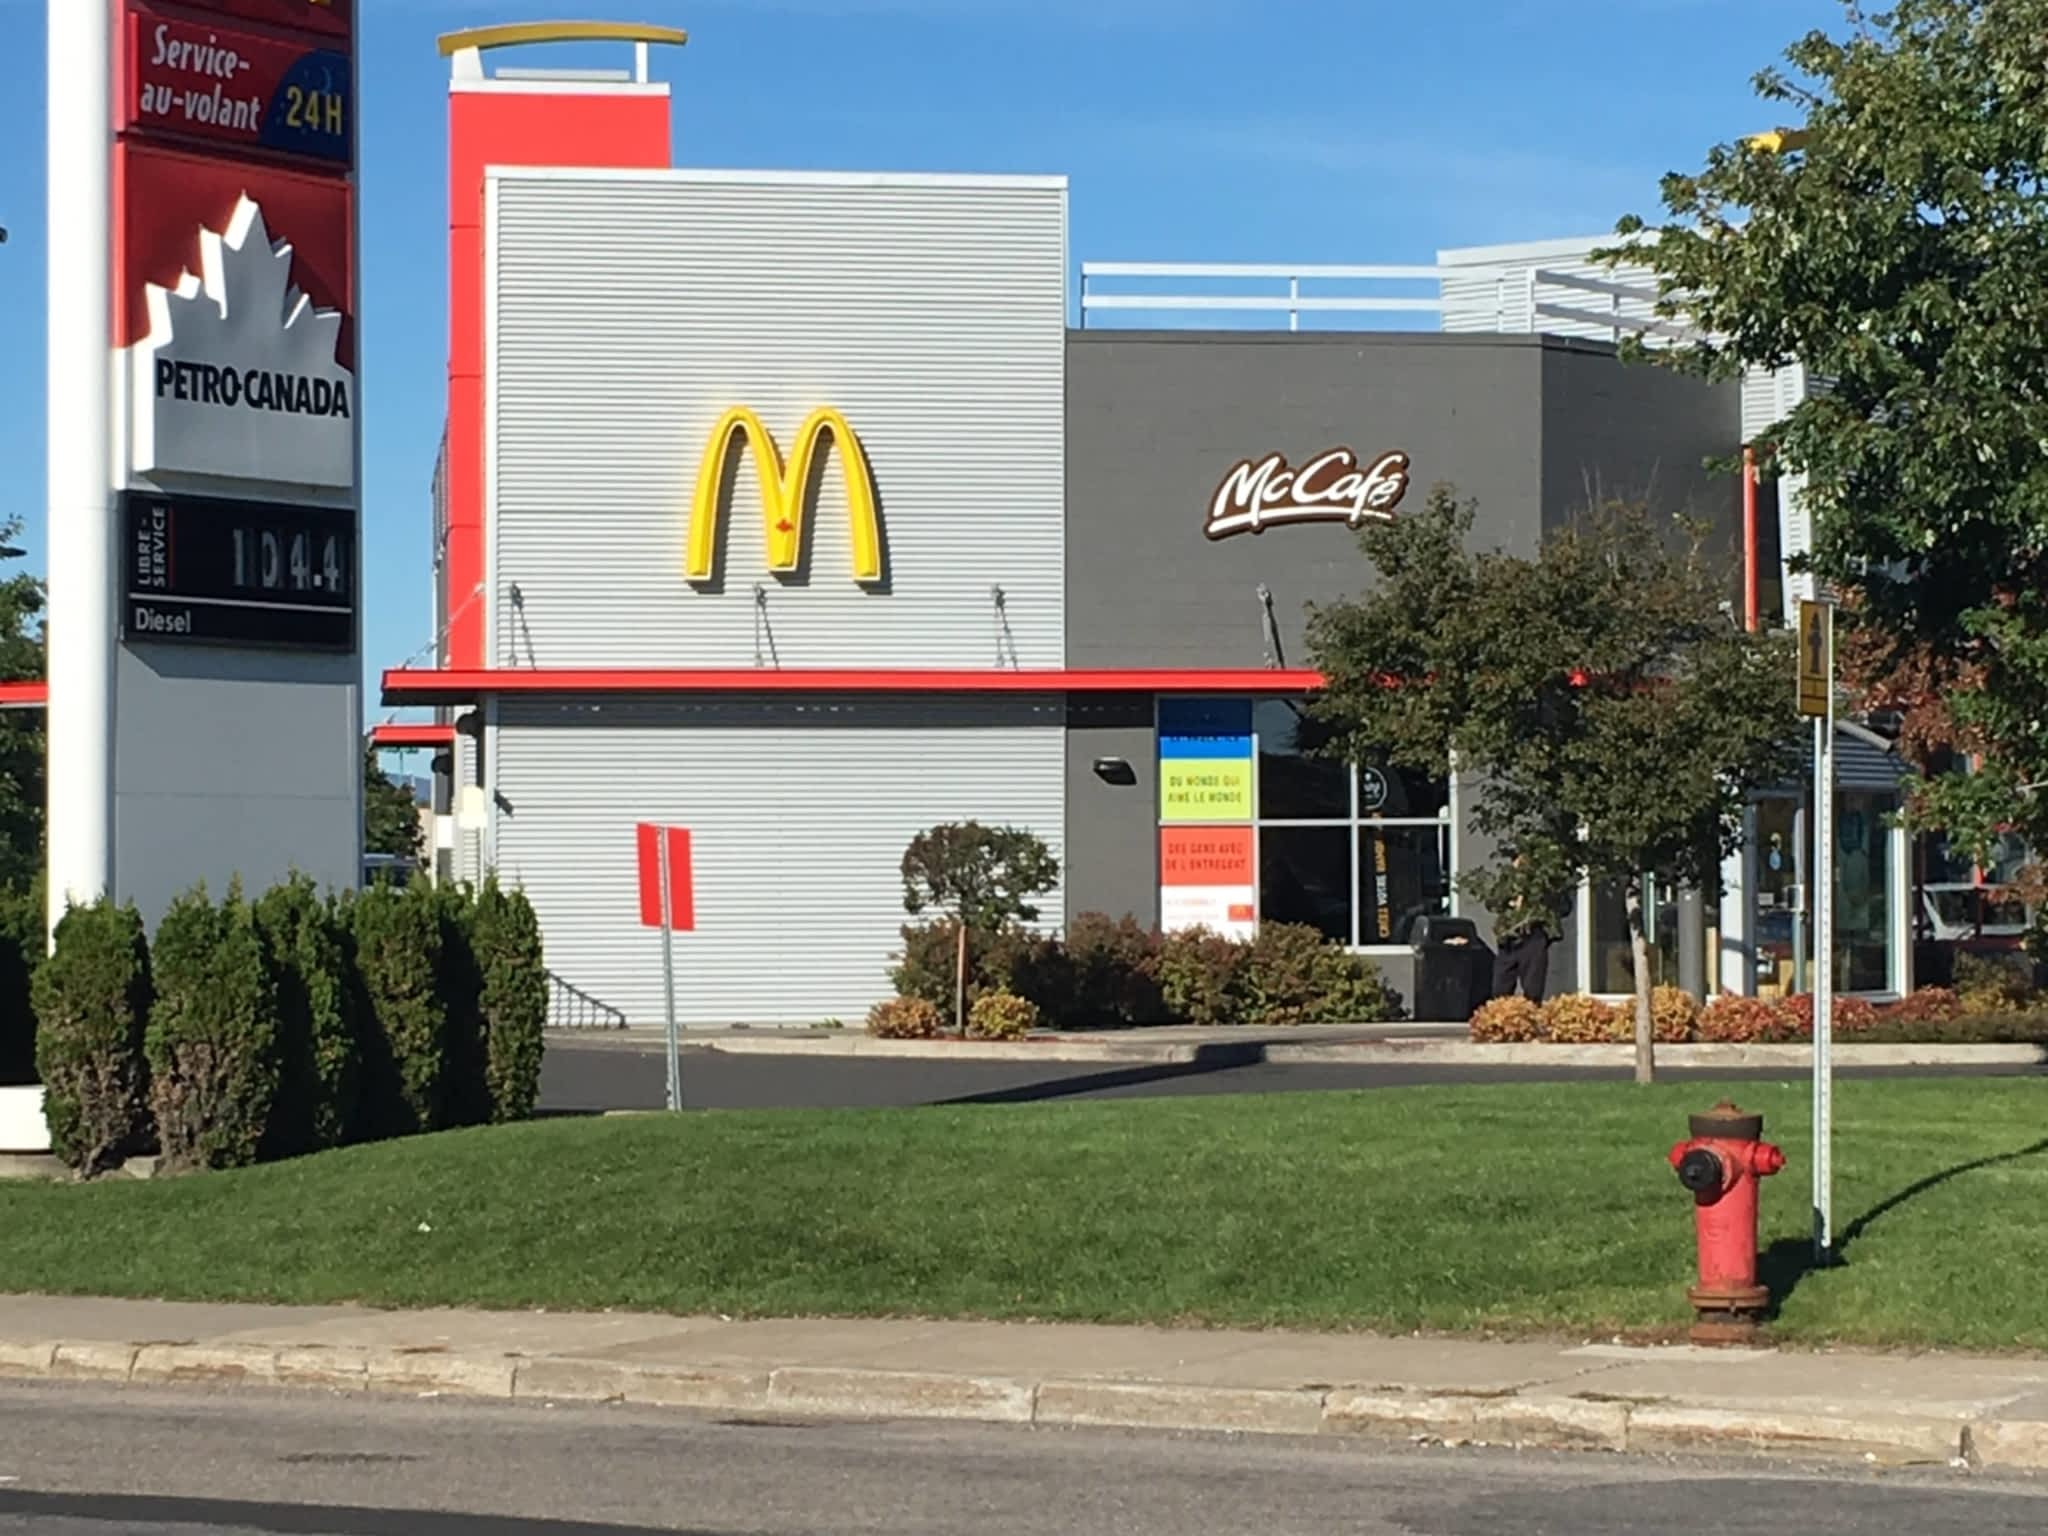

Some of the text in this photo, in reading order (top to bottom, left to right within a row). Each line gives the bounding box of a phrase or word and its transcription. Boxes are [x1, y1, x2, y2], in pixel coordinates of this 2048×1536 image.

[152, 24, 250, 79] Service-
[140, 83, 261, 132] au-volant
[286, 85, 343, 136] 24H
[1208, 449, 1404, 528] McCafé
[152, 507, 166, 587] SERVICE
[232, 528, 340, 592] 104.4
[135, 607, 192, 633] Diesel
[1186, 775, 1219, 787] MONDE
[1208, 791, 1242, 803] MONDE
